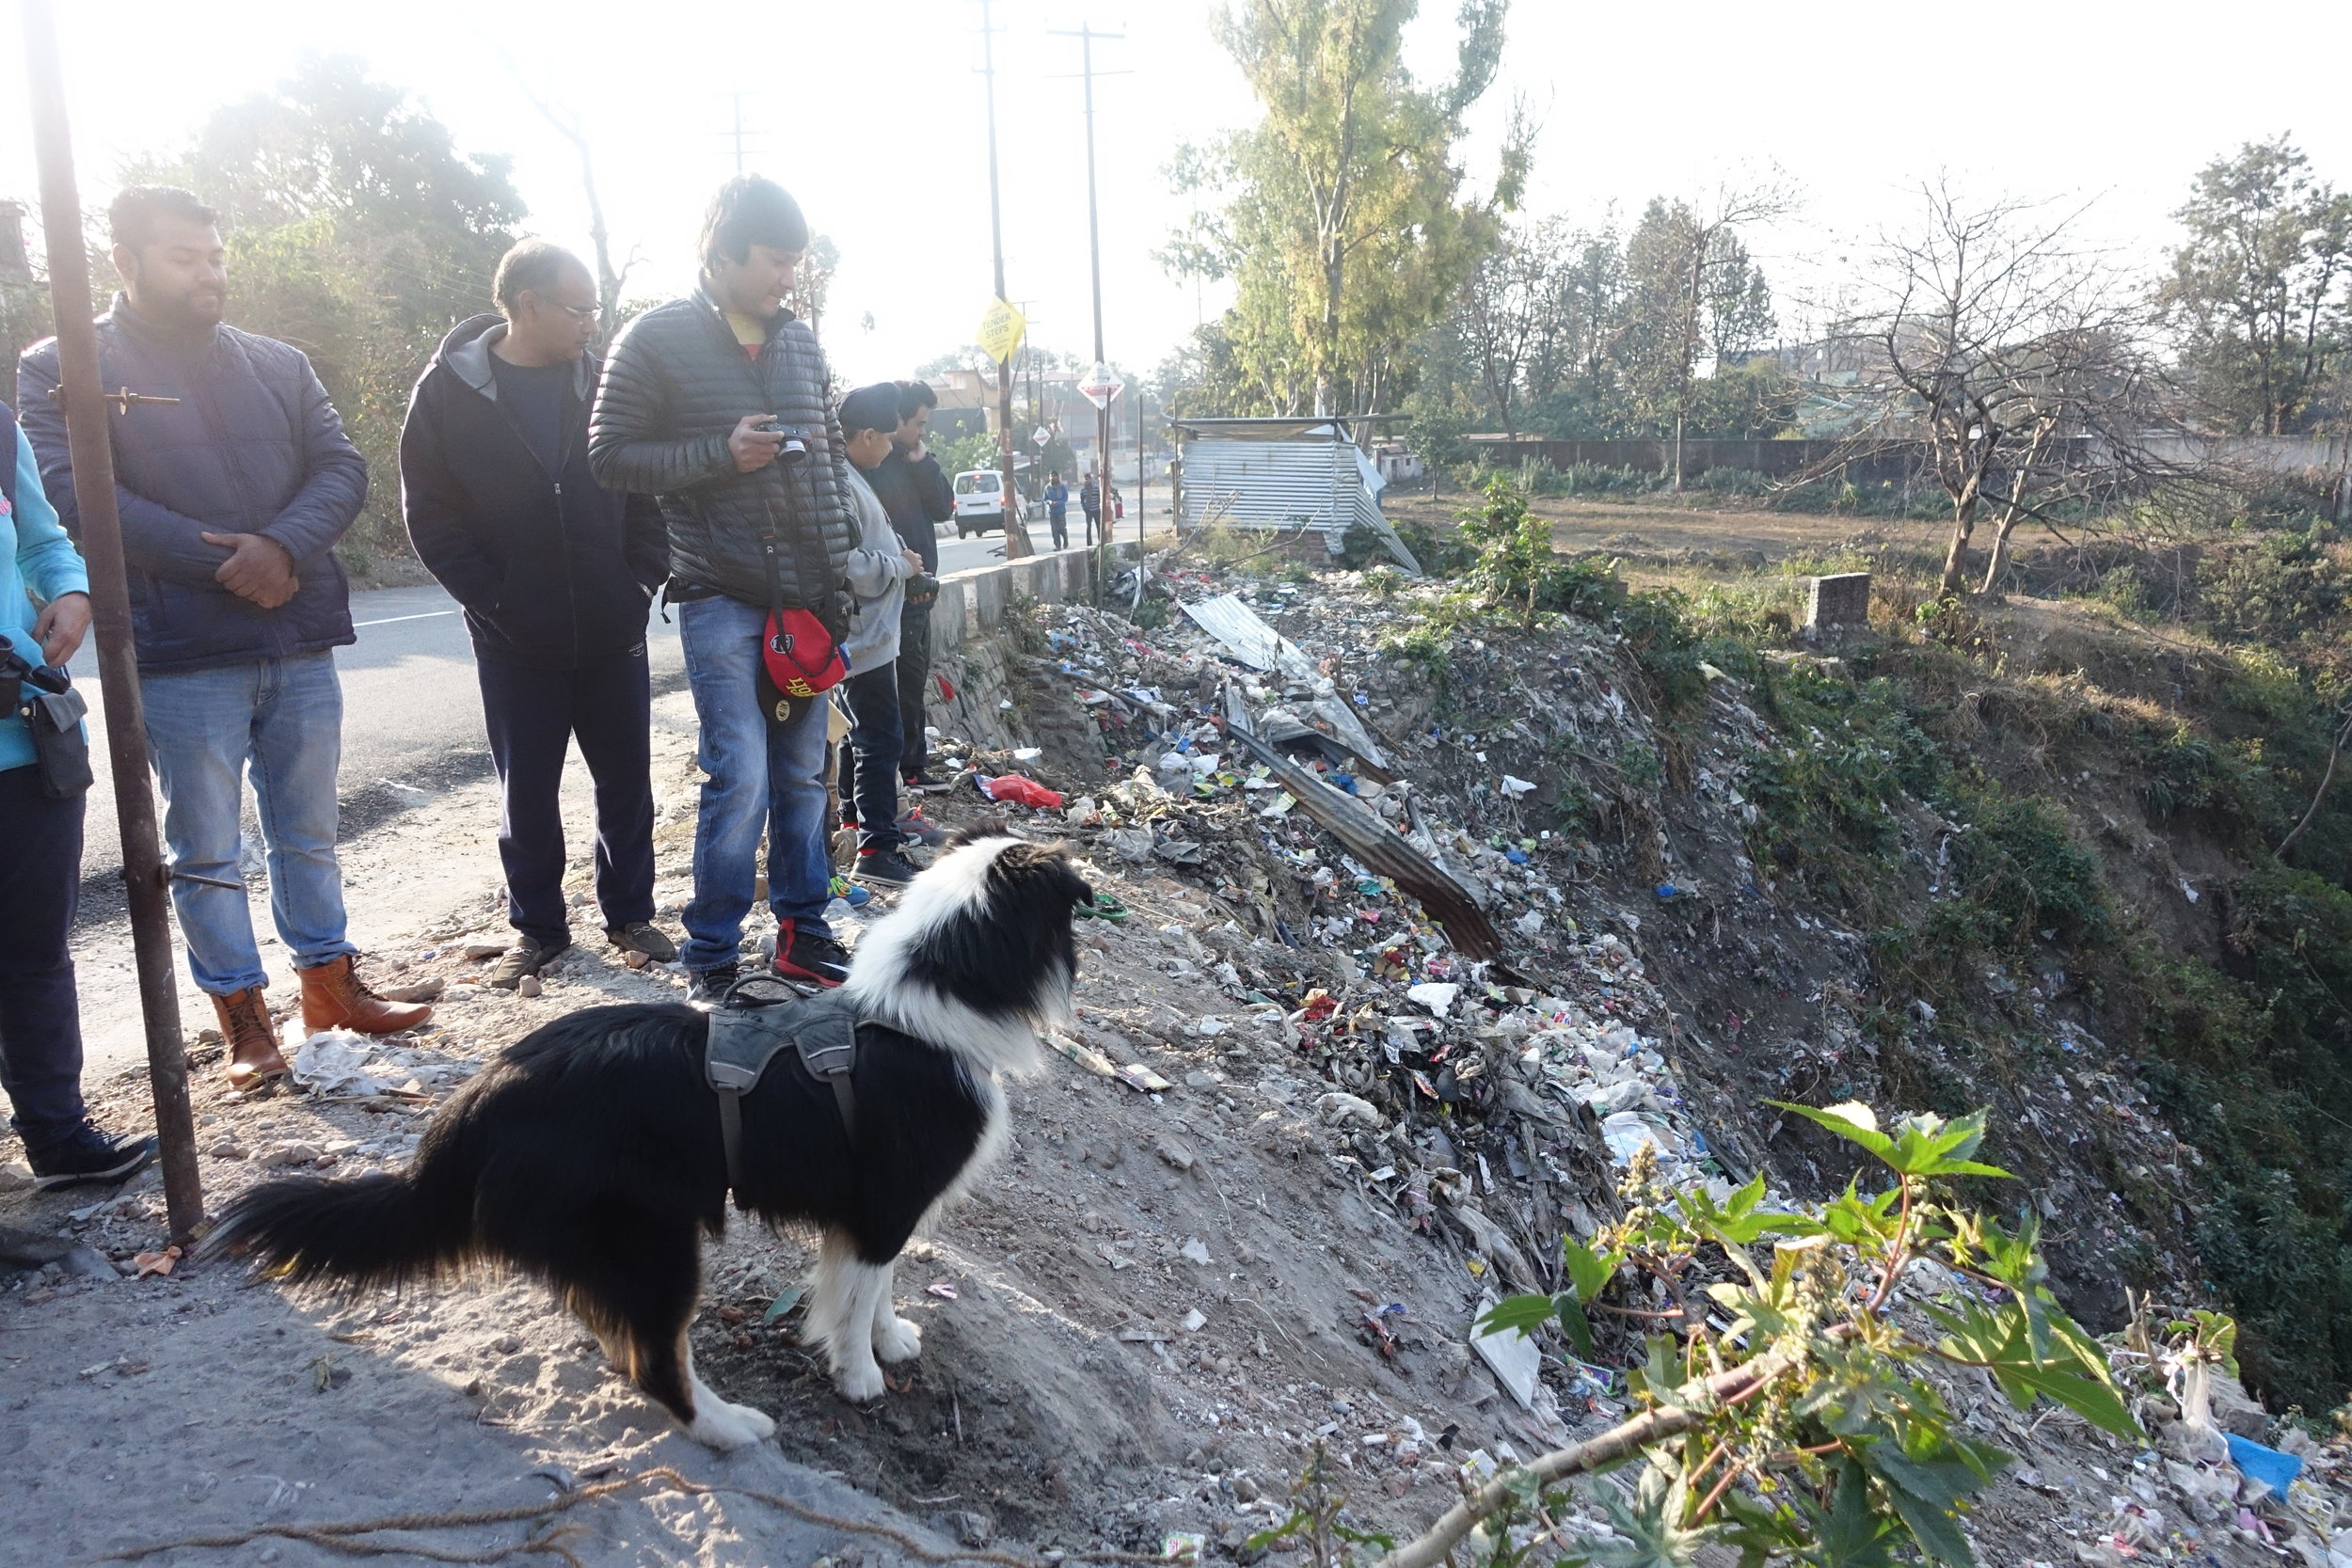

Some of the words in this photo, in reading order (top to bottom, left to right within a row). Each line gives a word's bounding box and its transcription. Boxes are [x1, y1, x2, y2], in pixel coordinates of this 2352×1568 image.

[982, 312, 1011, 330] TENDER
[985, 324, 1009, 339] STEPS
[786, 677, 816, 697] 49
